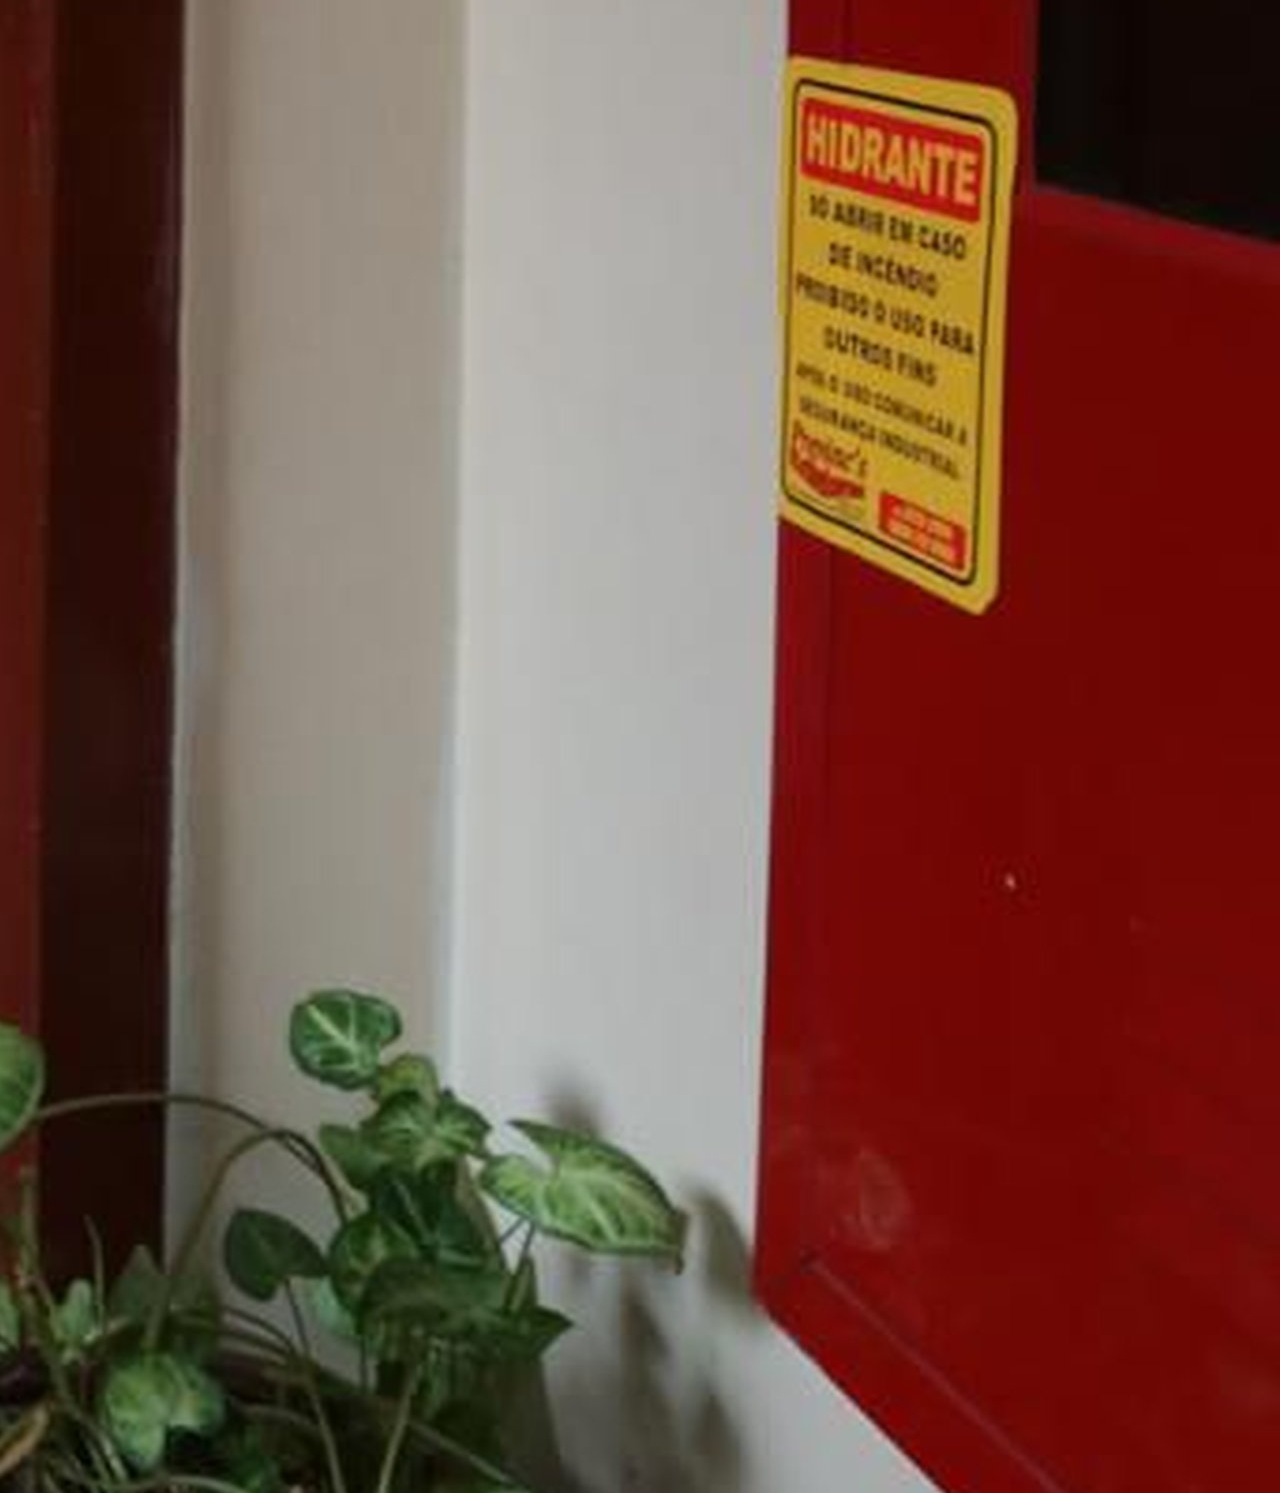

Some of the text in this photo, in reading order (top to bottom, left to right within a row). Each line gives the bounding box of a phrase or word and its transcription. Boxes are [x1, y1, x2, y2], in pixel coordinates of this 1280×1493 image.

[807, 111, 978, 206] HIDRANTE
[828, 242, 852, 270] DE
[889, 216, 913, 243] EM
[919, 225, 966, 260] CASO
[891, 307, 925, 338] USO
[930, 318, 974, 355] PARA
[824, 324, 937, 388] OUTROS FINS
